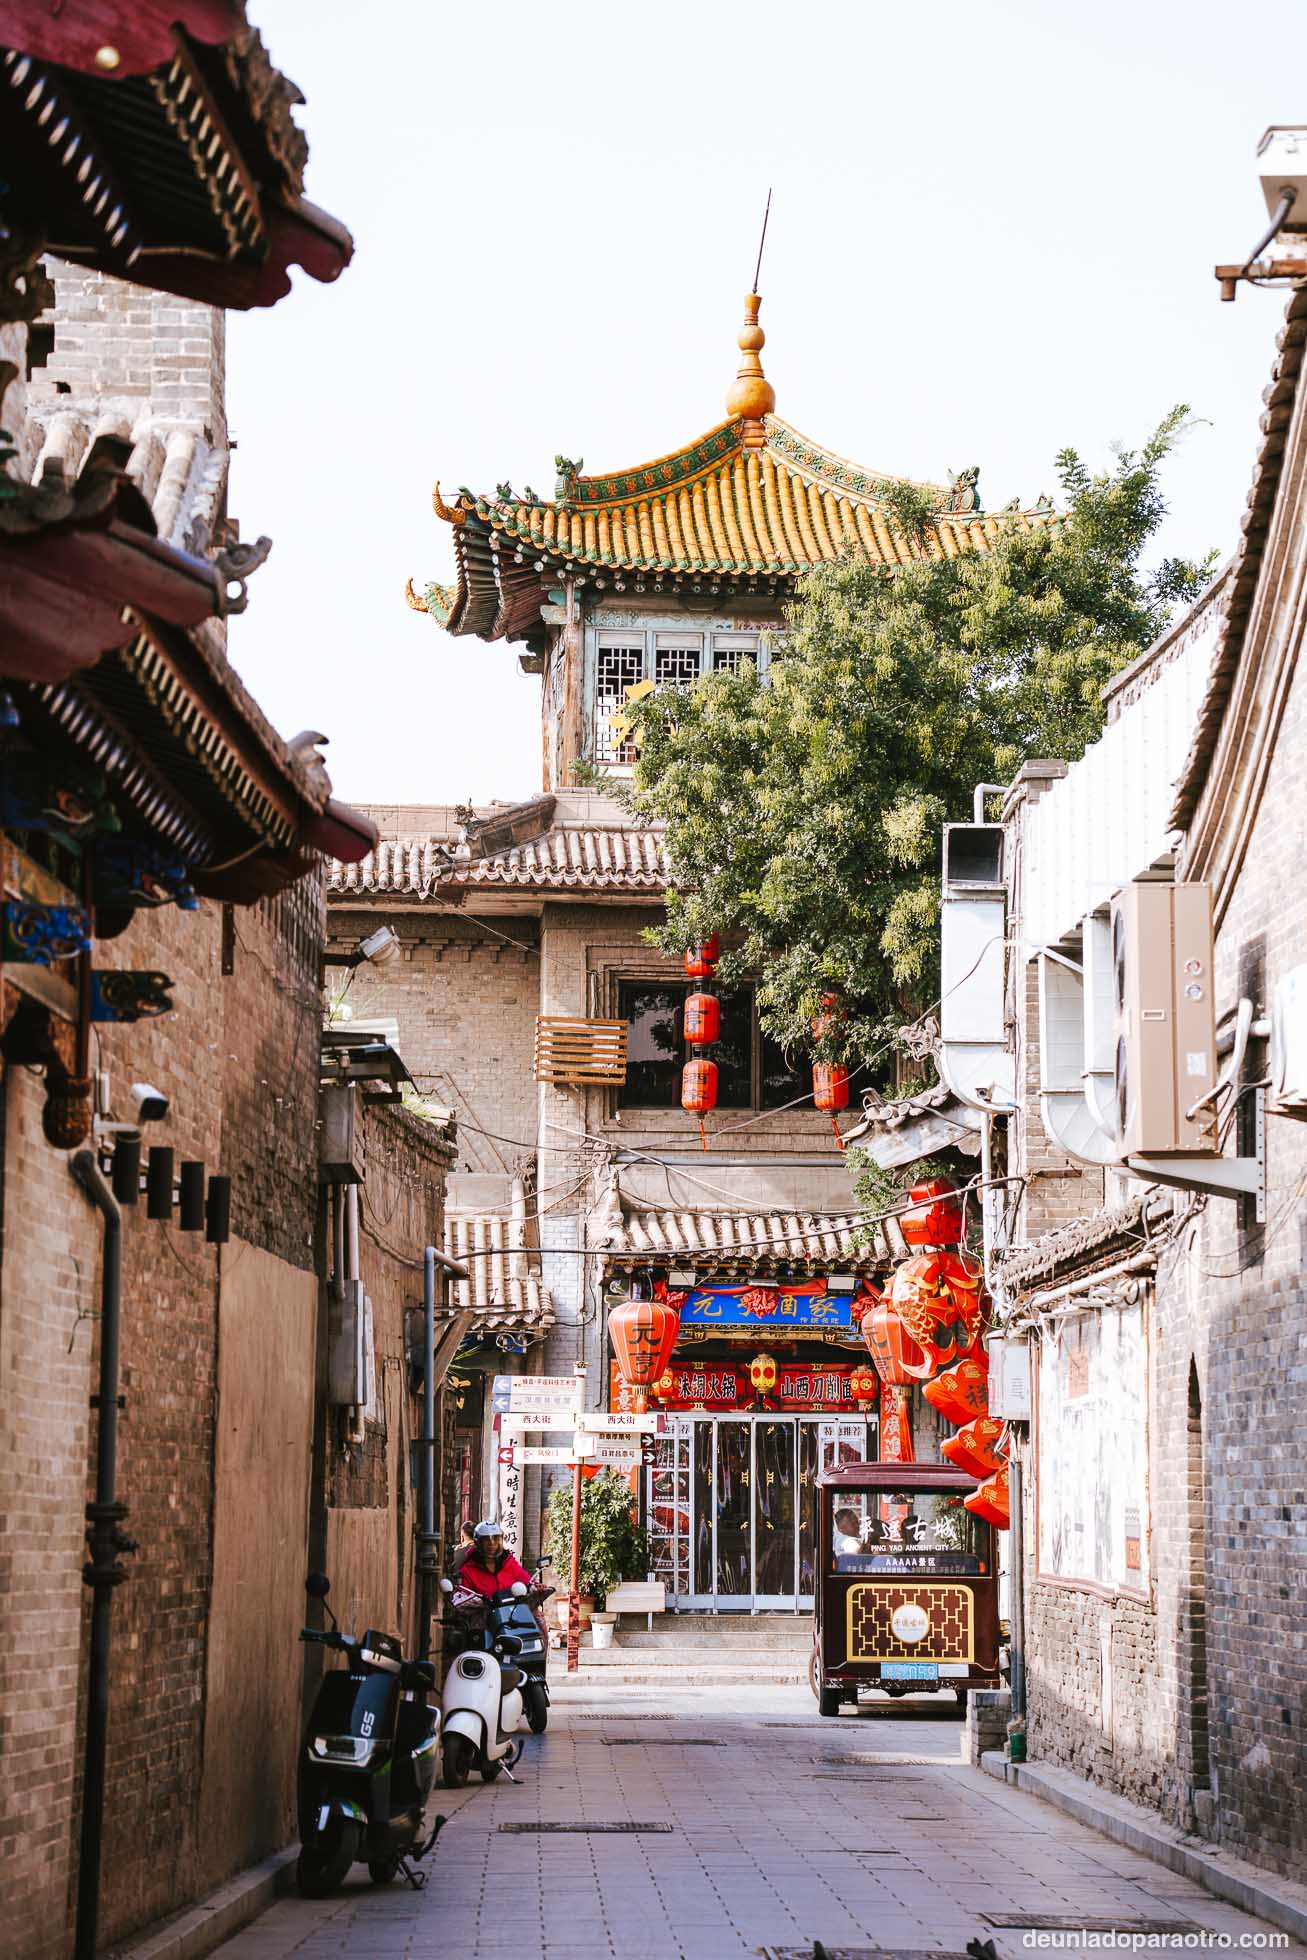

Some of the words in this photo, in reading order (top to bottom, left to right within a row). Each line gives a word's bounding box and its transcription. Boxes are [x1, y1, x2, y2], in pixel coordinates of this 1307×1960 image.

[629, 1322, 661, 1374] 元亨
[781, 1374, 853, 1401] 山西刀削面
[522, 1415, 551, 1424] 西大街
[607, 1415, 635, 1425] 西大街
[885, 1557, 936, 1567] AAAAA景区
